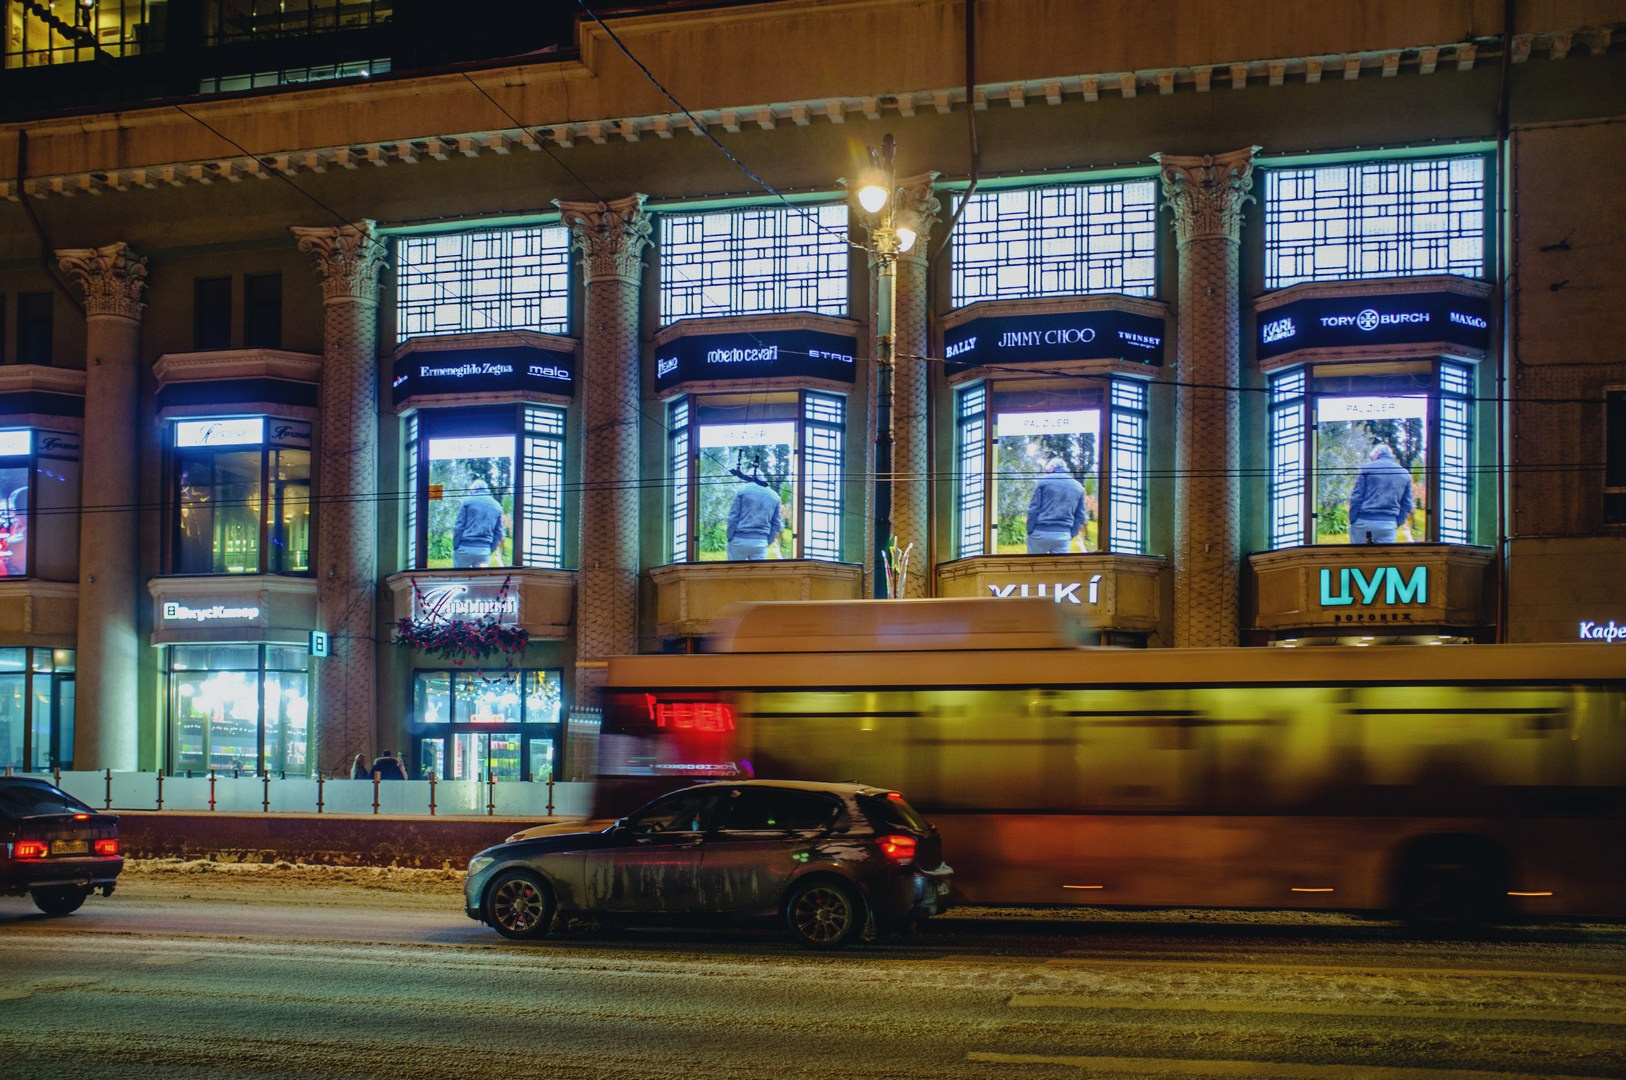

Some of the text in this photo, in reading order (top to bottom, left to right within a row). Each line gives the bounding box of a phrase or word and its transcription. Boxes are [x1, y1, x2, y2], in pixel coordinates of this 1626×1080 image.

[1320, 312, 1430, 327] TORY BURCH
[1263, 317, 1295, 338] KARL
[998, 328, 1096, 347] JIMMY CHOO
[1118, 331, 1160, 345] TWINSET
[946, 337, 977, 358] BALLY
[707, 348, 743, 363] roberto
[809, 350, 853, 363] ETRO
[420, 363, 513, 377] Ermenegildo Zegna
[529, 366, 569, 378] malo
[1320, 566, 1427, 606] ЦУМ
[1580, 621, 1626, 643] Кафе
